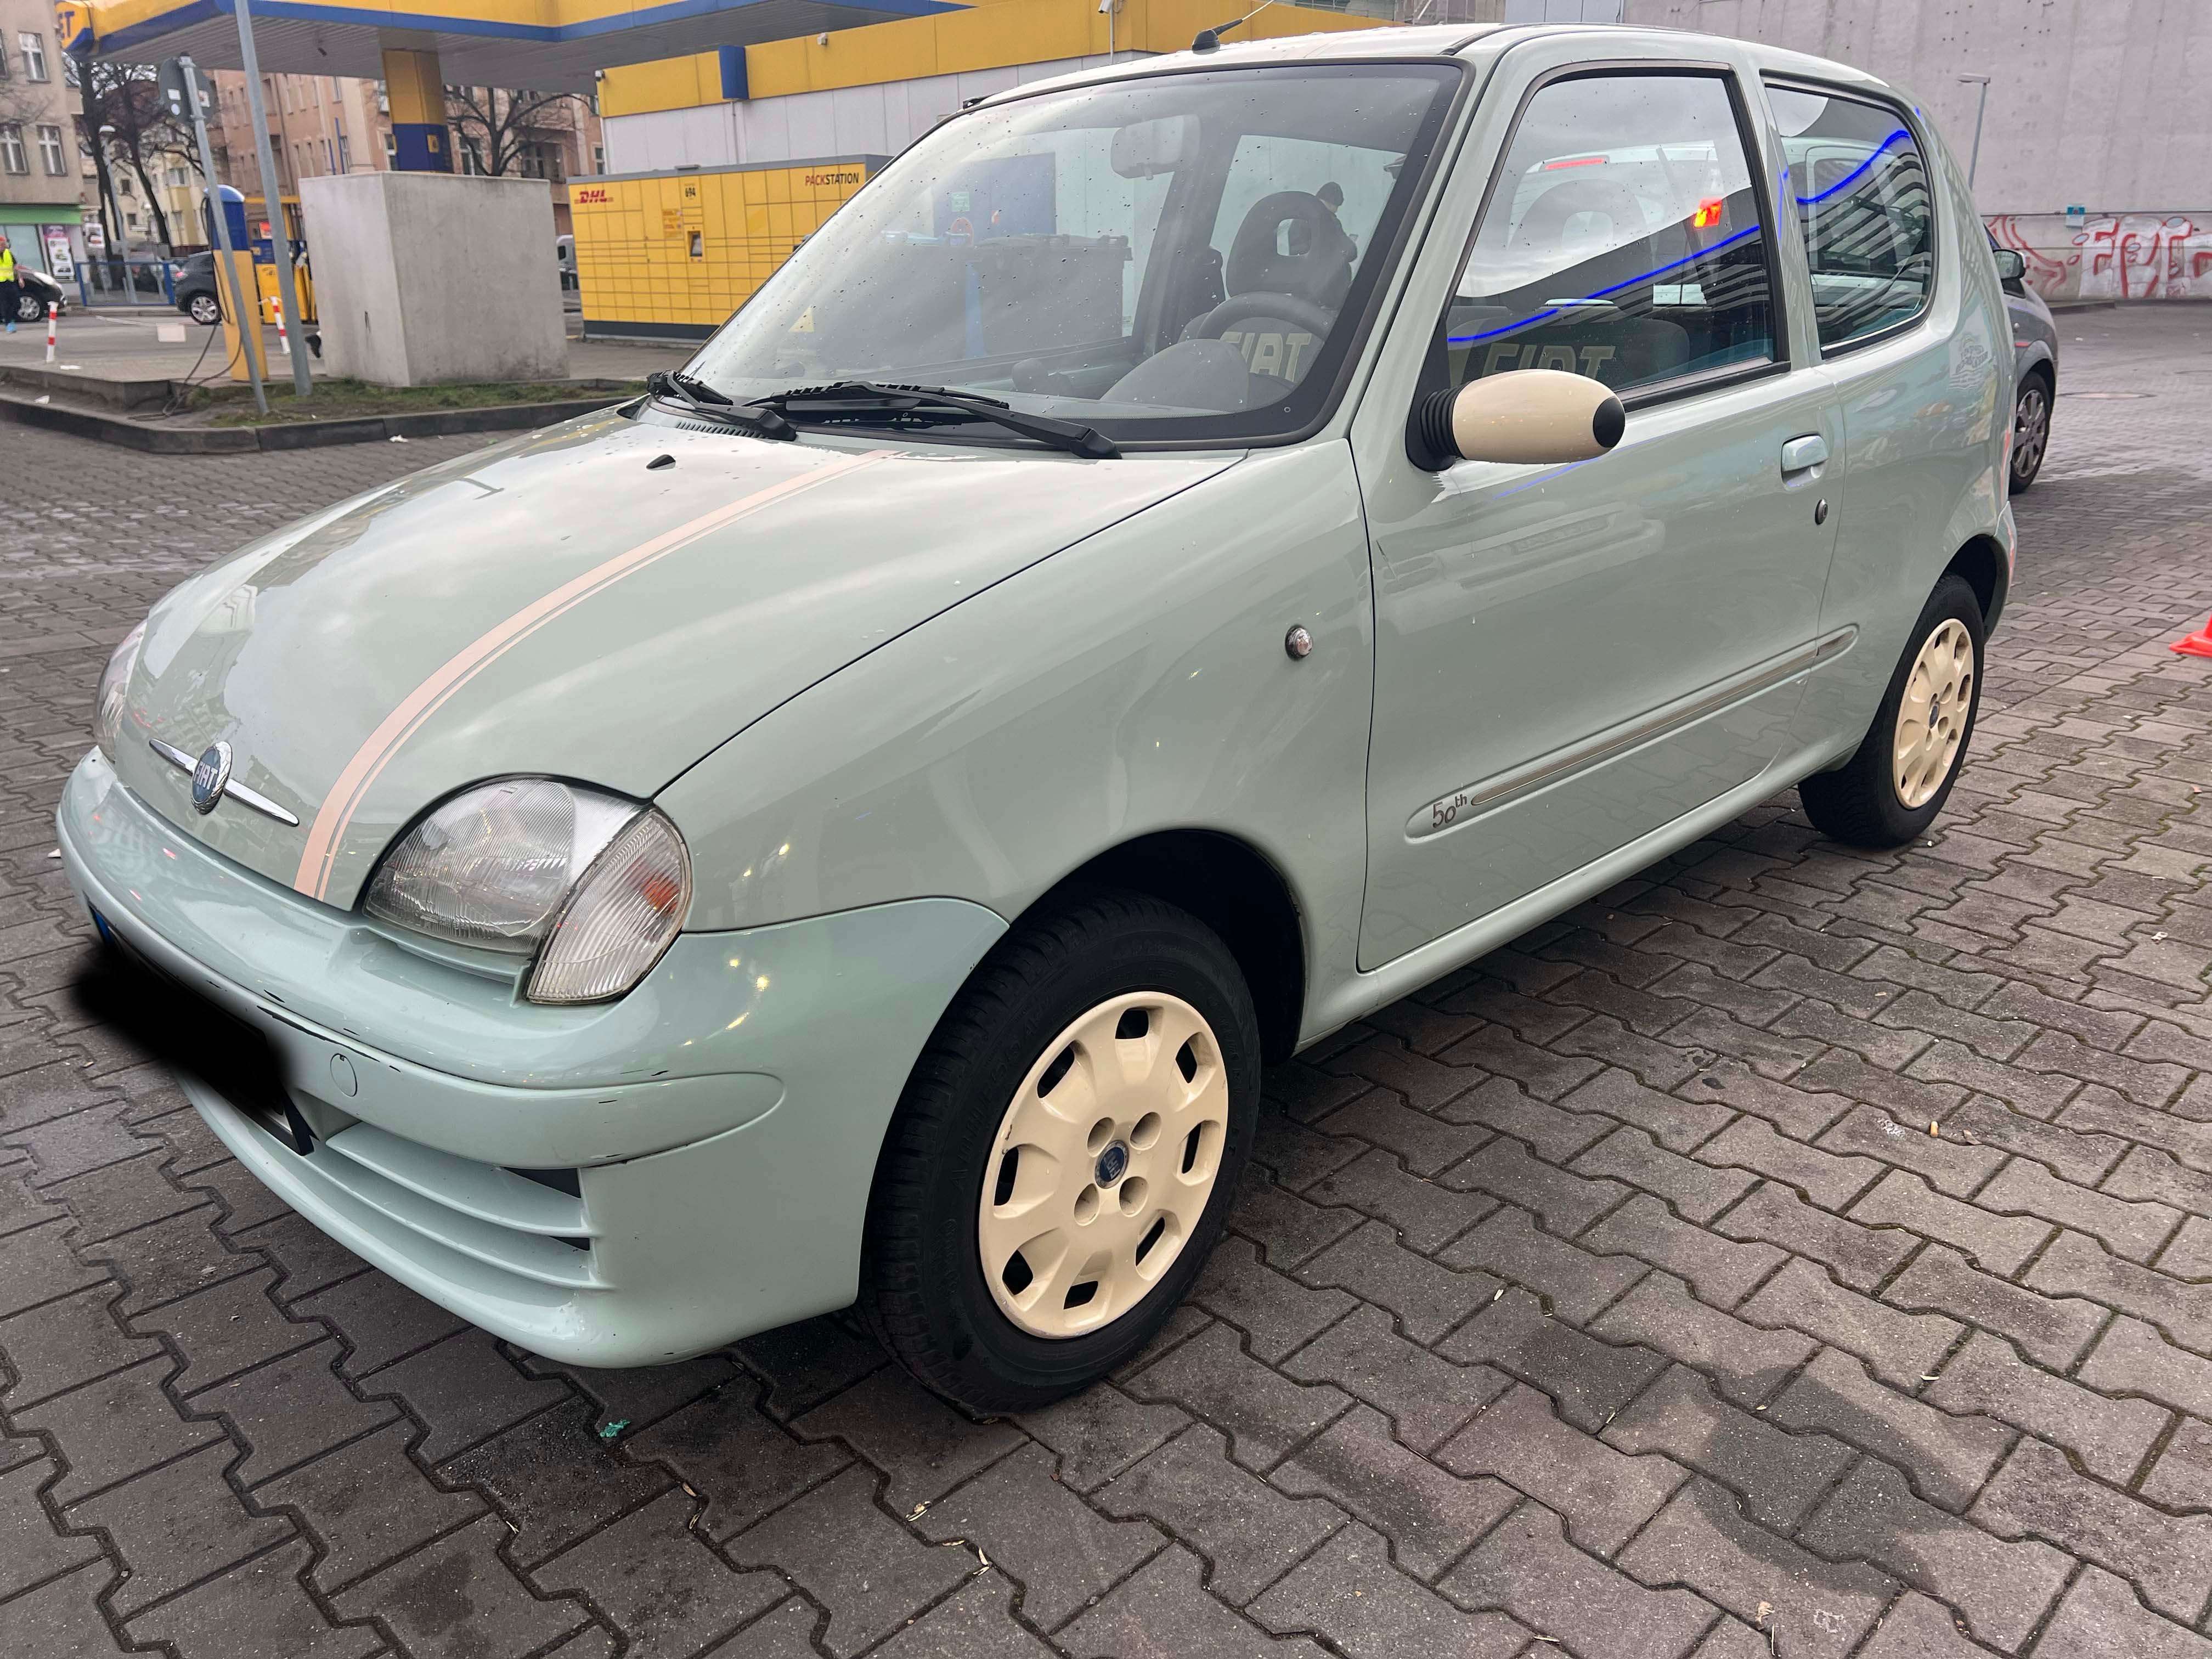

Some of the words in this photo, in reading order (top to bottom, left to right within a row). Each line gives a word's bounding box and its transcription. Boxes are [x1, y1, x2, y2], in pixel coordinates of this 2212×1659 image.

[805, 172, 859, 186] PACKSTATION
[579, 189, 607, 204] DHL
[193, 760, 218, 790] FIAT
[1432, 794, 1468, 828] 50th
